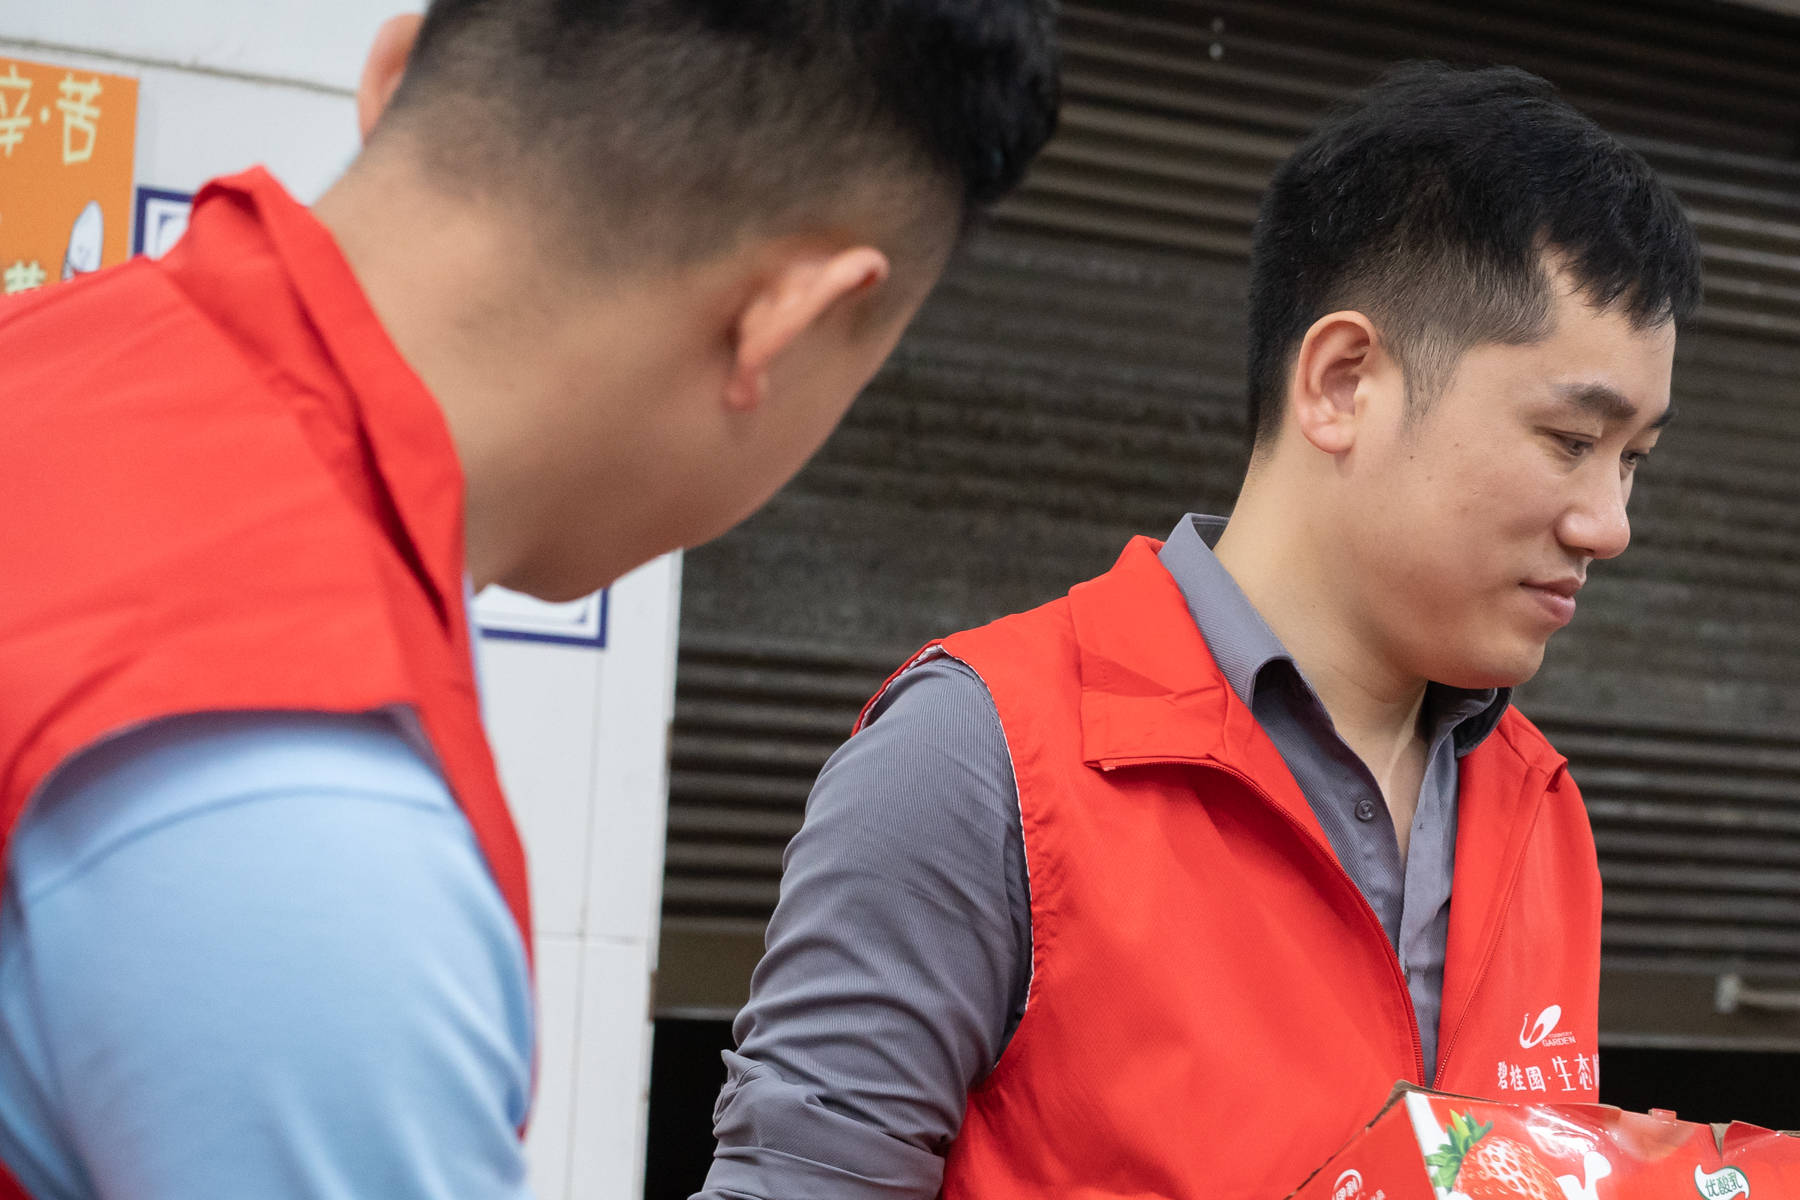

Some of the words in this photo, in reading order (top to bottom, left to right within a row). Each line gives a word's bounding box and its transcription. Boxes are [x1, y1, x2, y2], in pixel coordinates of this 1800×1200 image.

[1542, 1036, 1577, 1047] GARDEN
[1705, 1172, 1743, 1197] 优酸乳
